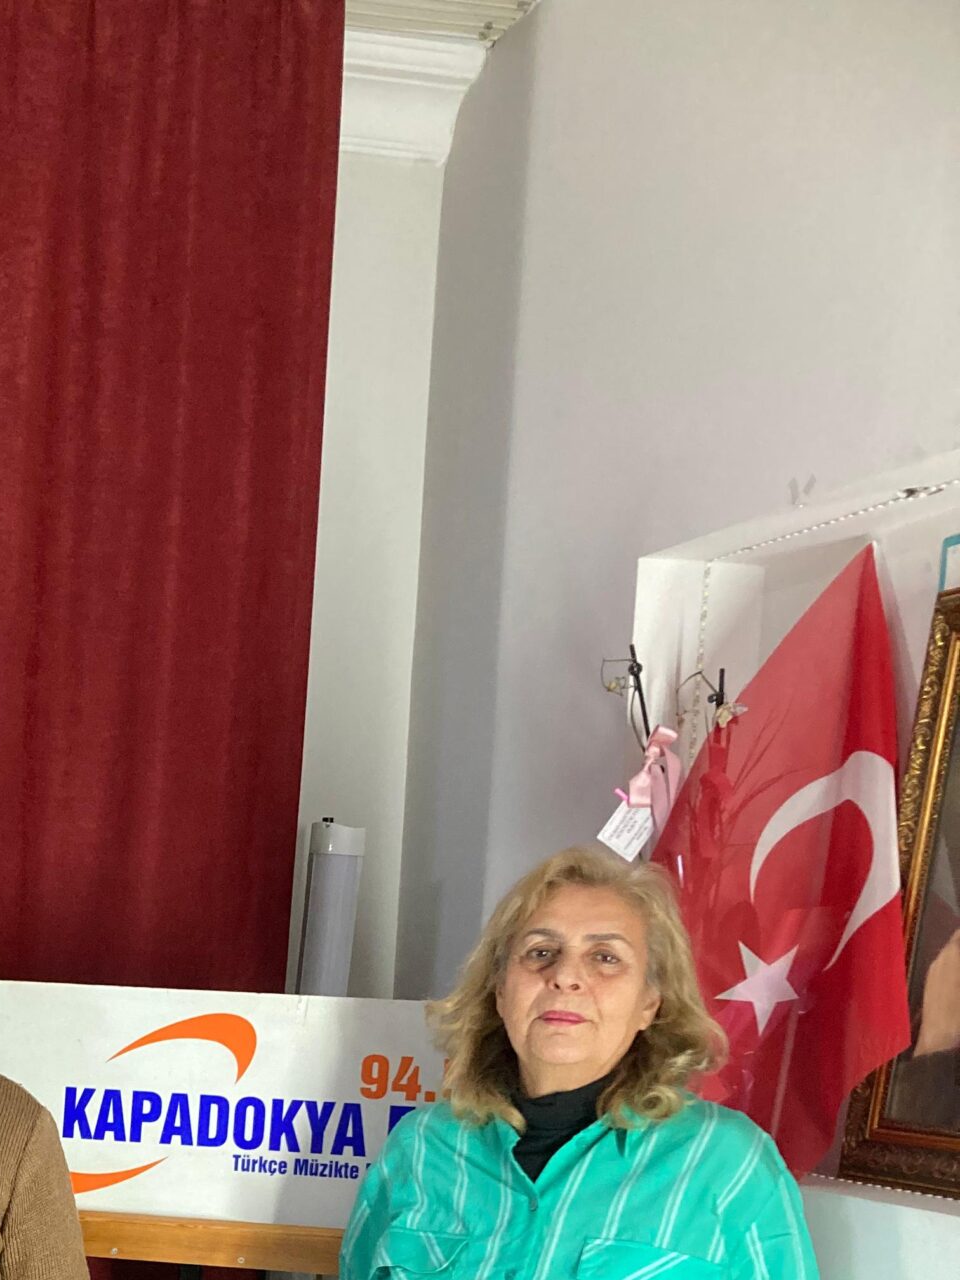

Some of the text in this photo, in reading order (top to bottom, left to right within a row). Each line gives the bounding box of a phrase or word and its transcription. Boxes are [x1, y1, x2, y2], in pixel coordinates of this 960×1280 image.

[359, 1054, 449, 1102] 94.
[62, 1086, 366, 1157] KAPADOKYA
[232, 1154, 359, 1180] Türkçe Müzikte
